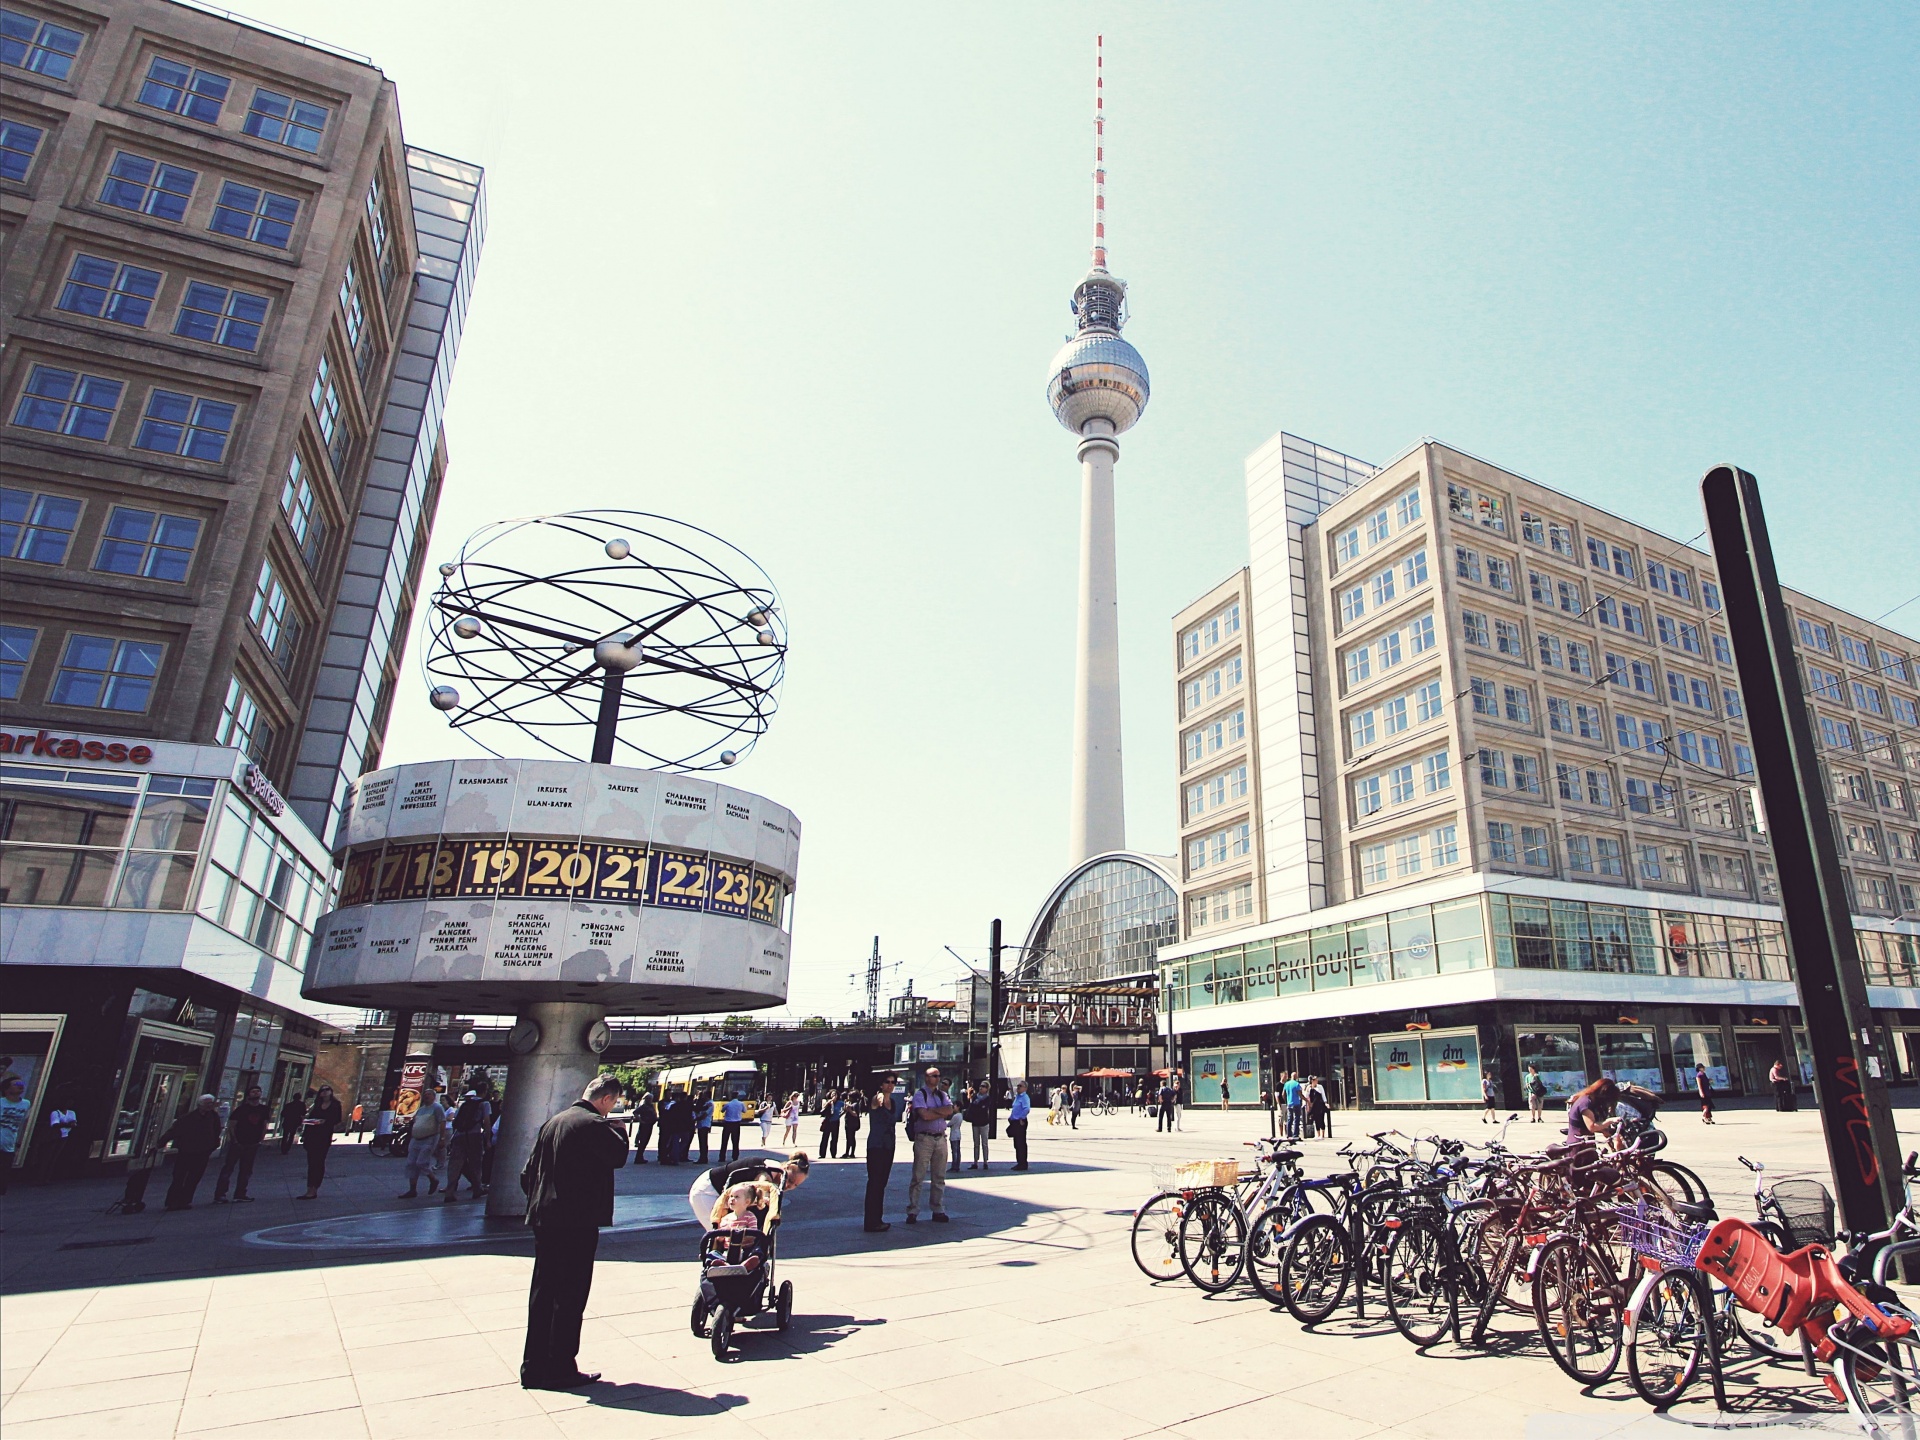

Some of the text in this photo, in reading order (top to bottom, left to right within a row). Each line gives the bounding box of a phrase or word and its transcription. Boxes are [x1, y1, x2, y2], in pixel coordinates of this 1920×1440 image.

[250, 764, 285, 817] Sparkasse
[608, 784, 639, 793] JAKUTSK
[403, 794, 437, 803] TASCHKENT
[527, 800, 573, 808] ULAN-BATOR
[665, 798, 706, 811] WLADIWOSTOK
[666, 792, 706, 804] CHABAROWSK
[400, 801, 437, 810] NOWOSIBIRSK
[726, 803, 750, 814] MAGADAN
[725, 809, 750, 820] SACHALIN
[370, 854, 405, 890] 17
[414, 850, 454, 886] 18
[471, 850, 520, 884] 19
[527, 850, 592, 888] 20
[601, 854, 648, 890] 21
[343, 862, 362, 897] 16
[661, 861, 710, 898] 22
[714, 869, 750, 905] 23
[752, 878, 776, 914] 24
[591, 931, 613, 939] TOKYO
[370, 938, 395, 947] RANGUN
[377, 946, 399, 954] DHAKA
[494, 951, 520, 959] KUALA
[648, 957, 685, 965] CANBERRA
[1248, 946, 1366, 988] CLOCKHOUSE
[645, 964, 685, 972] MELBOURNE
[1000, 1004, 1154, 1026] ALEXANDER
[1390, 1048, 1408, 1063] dm
[1443, 1044, 1463, 1060] dm
[404, 1065, 427, 1074] KFC
[1204, 1059, 1216, 1072] dm
[1237, 1057, 1250, 1070] dm
